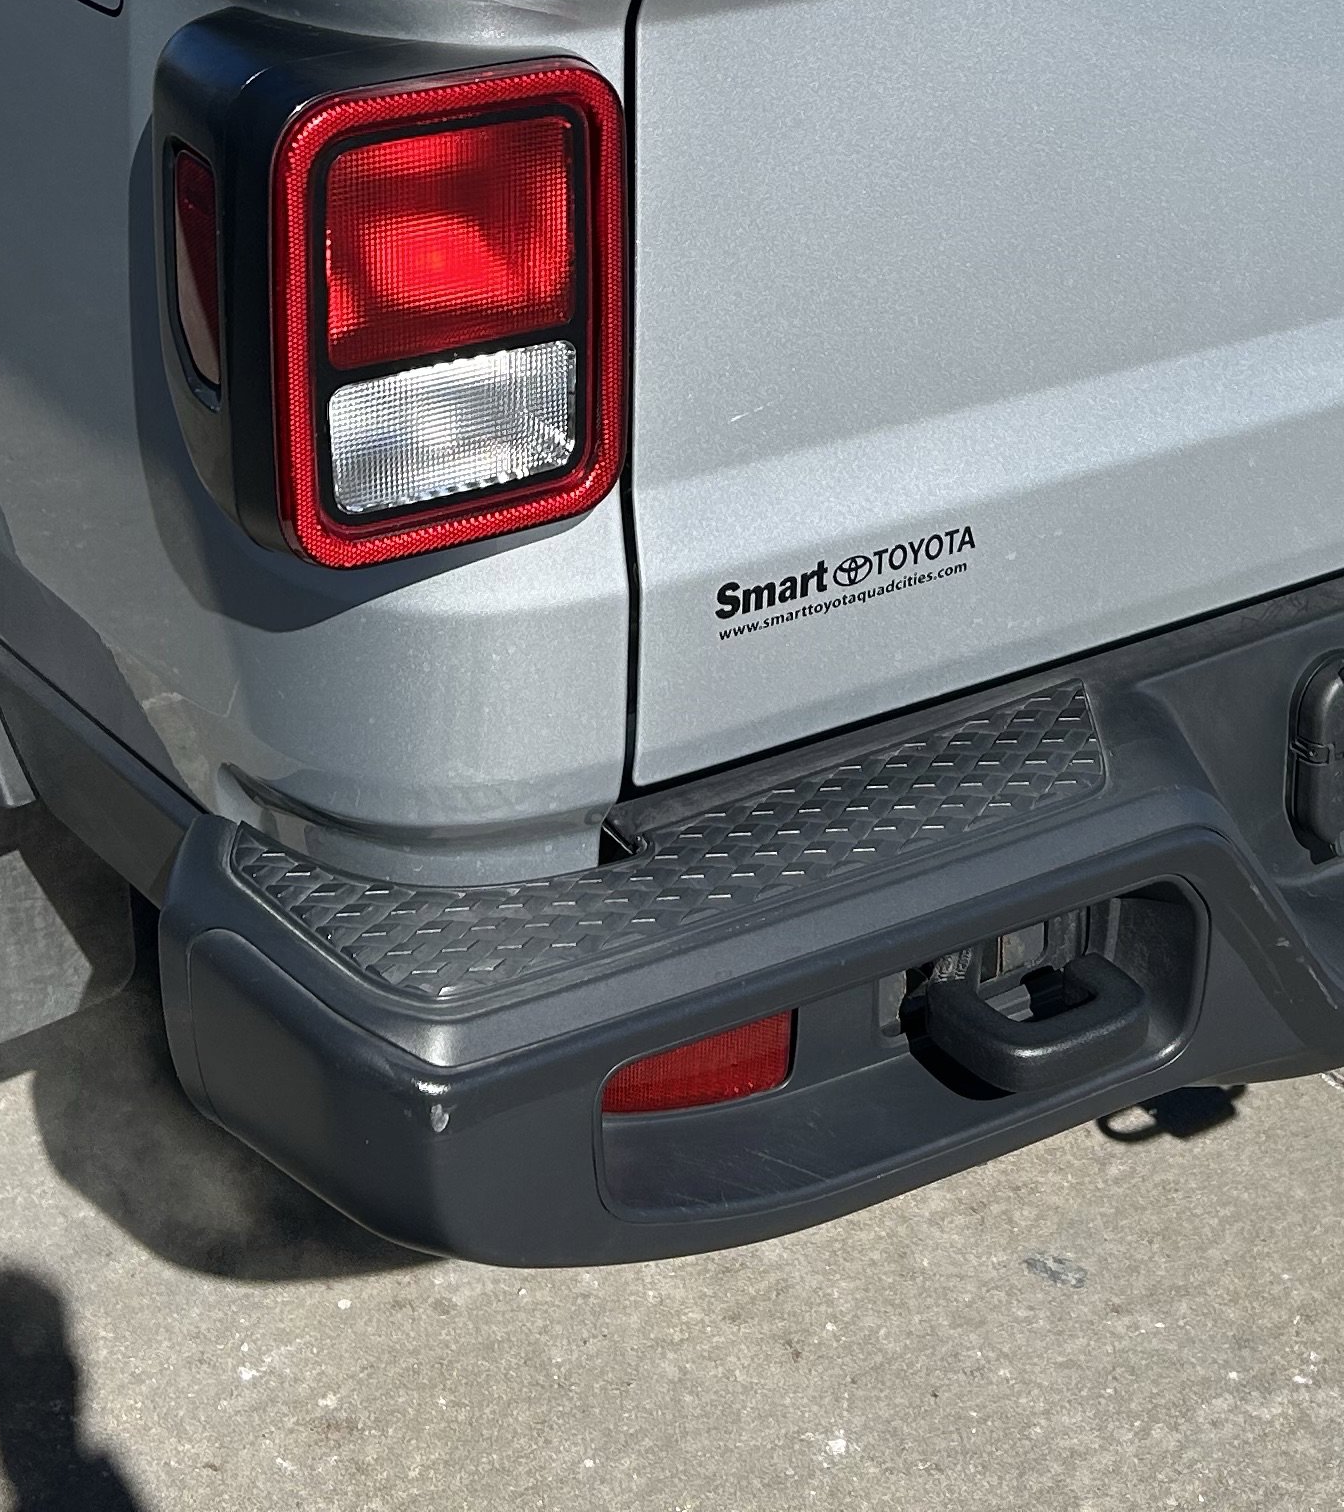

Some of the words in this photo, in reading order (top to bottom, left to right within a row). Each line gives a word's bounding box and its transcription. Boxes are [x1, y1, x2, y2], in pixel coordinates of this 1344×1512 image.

[715, 560, 828, 619] Smart
[873, 526, 976, 575] TOYOTA
[718, 562, 967, 641] www.smarttoyotaquadcities.com
